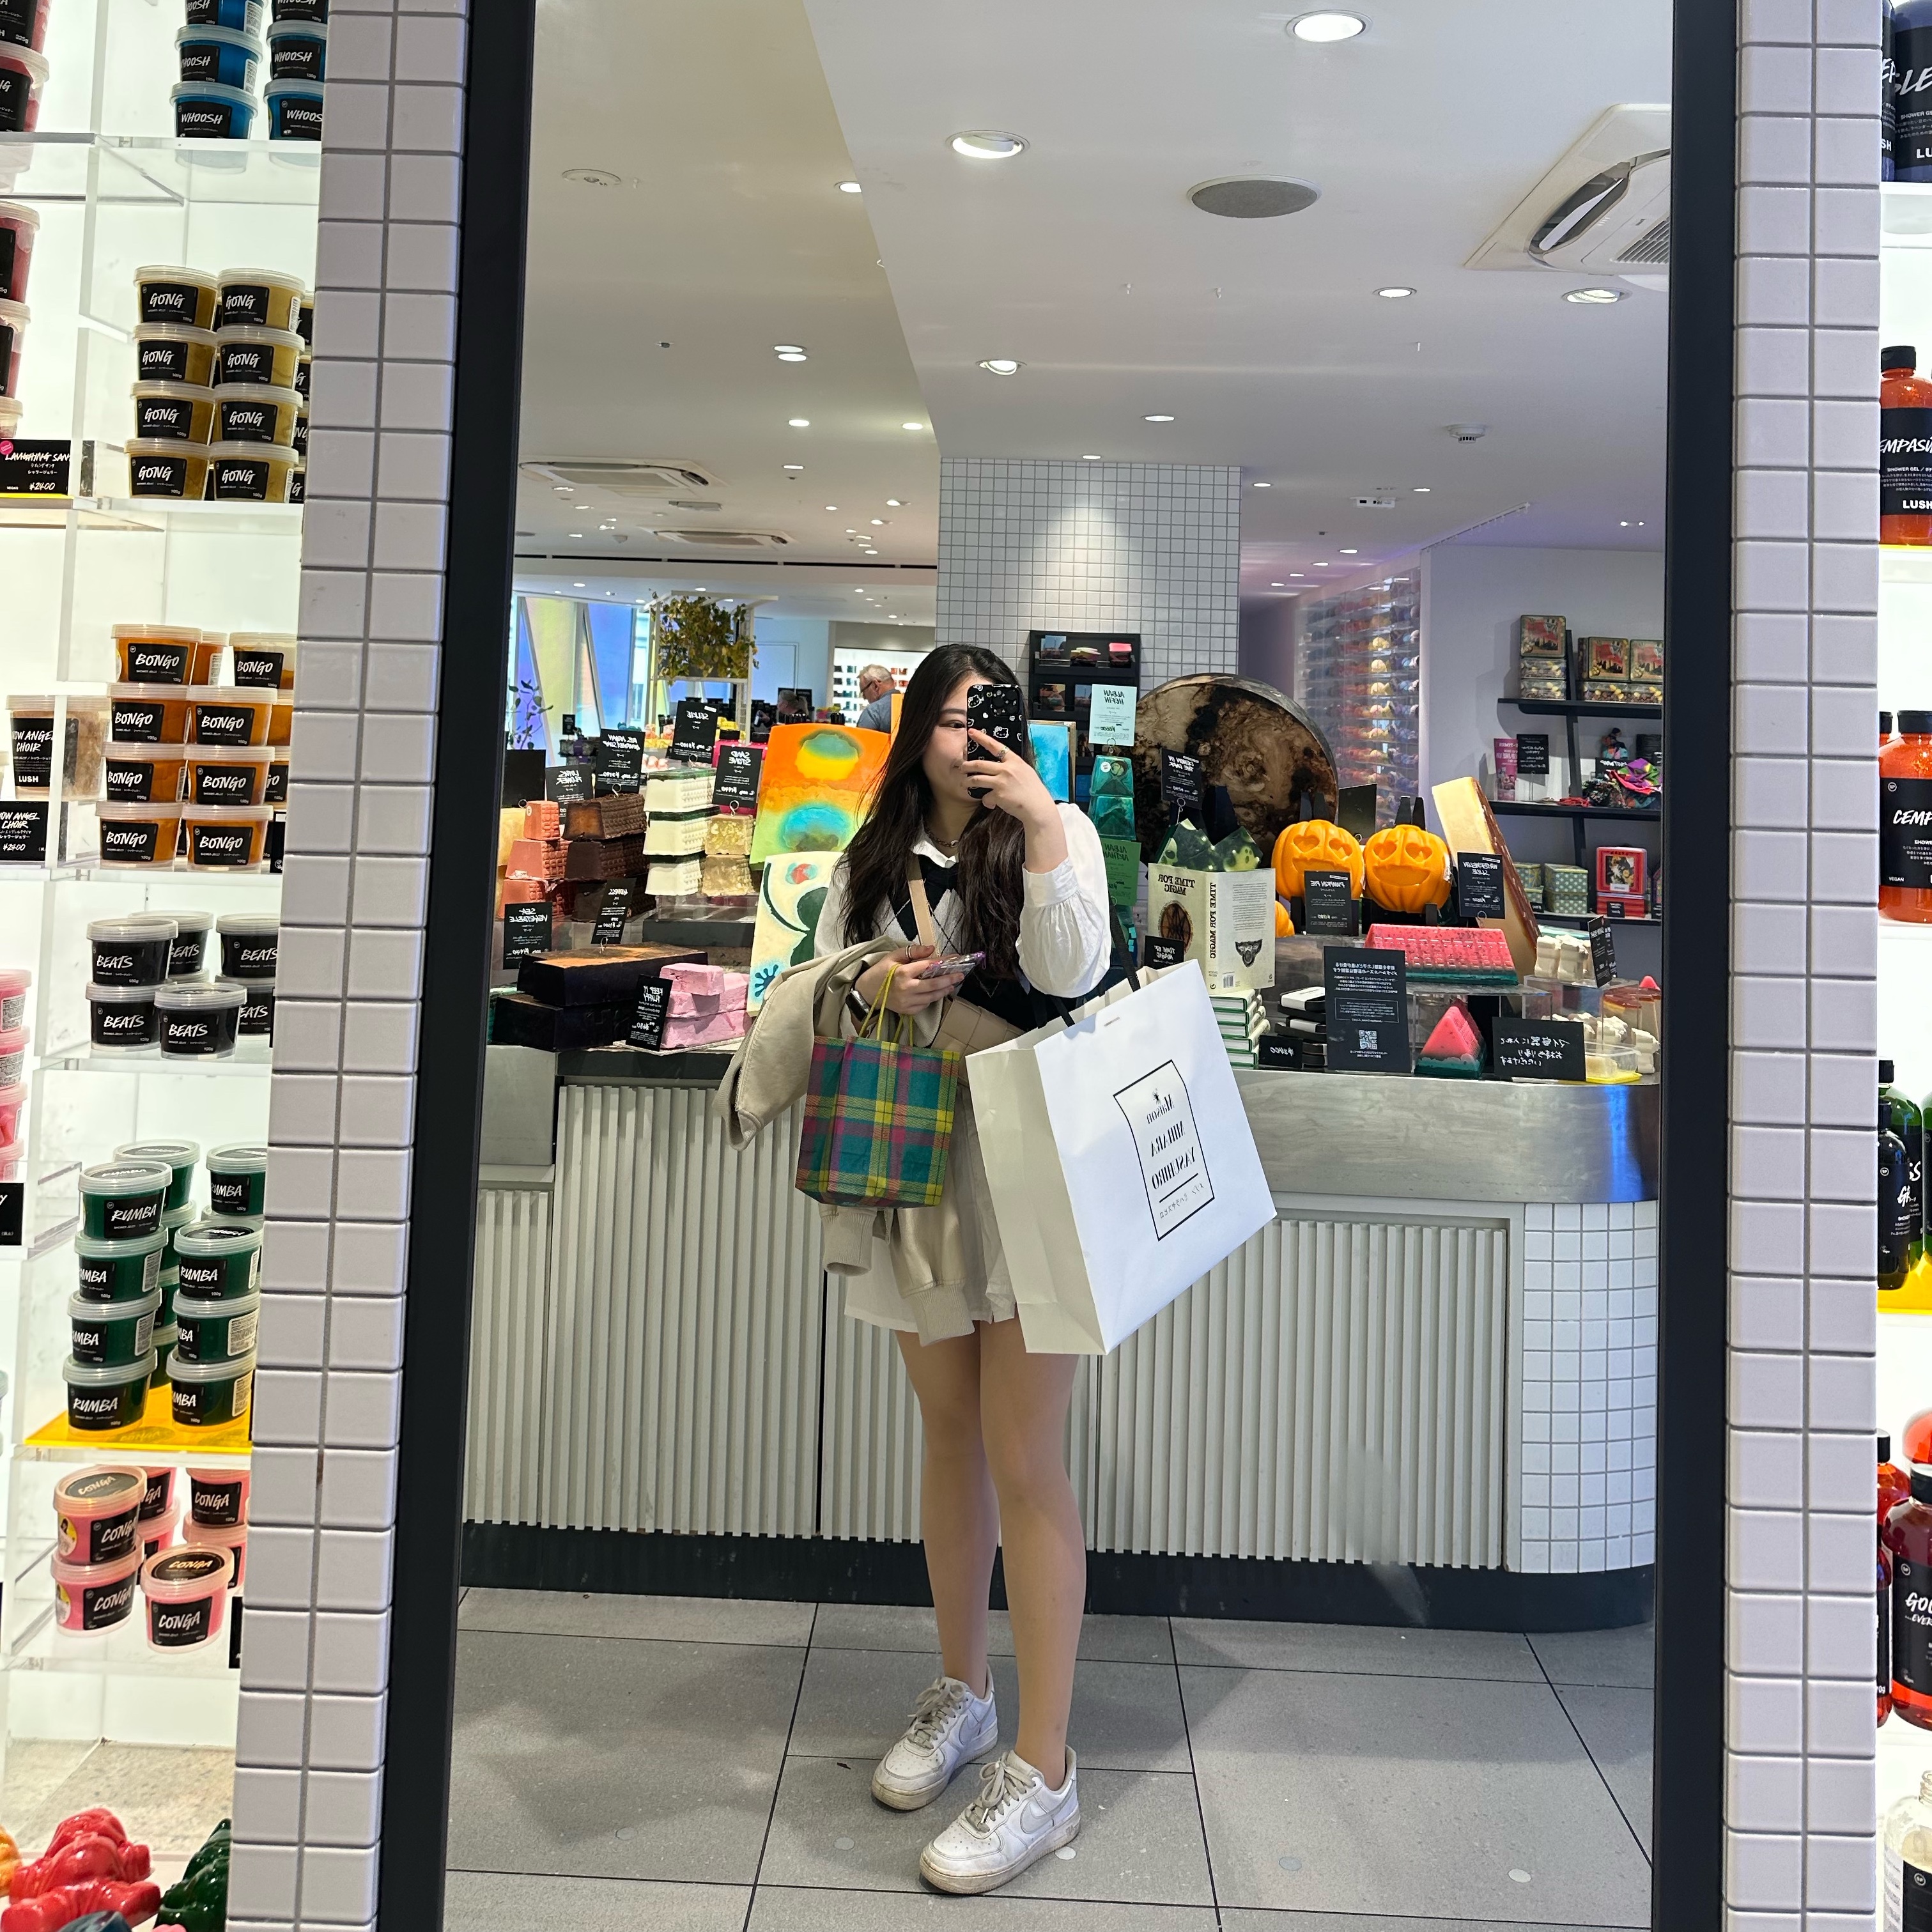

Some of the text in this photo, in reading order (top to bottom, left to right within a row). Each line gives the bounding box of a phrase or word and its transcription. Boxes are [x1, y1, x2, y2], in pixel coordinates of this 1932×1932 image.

[274, 52, 313, 63] WHOOSH
[181, 113, 223, 124] WHOOSH
[1901, 111, 1925, 120] SHOWER
[150, 293, 185, 309] GONG
[226, 294, 256, 309] GONG
[142, 350, 174, 366] GONG
[227, 353, 259, 367] GONG
[144, 408, 180, 424] GONG
[229, 411, 265, 427] GONG
[5, 452, 52, 461] LAUGHING
[138, 465, 174, 481] GONG
[222, 468, 256, 484] GONG
[29, 482, 56, 491] ¥2400
[135, 653, 180, 669] BONGO
[236, 660, 274, 676] BONGO
[114, 712, 153, 727] BONGO
[201, 716, 244, 733] BONGO
[16, 742, 41, 752] CHOIR
[107, 771, 143, 787] BONGO
[202, 776, 247, 792] BONGO
[13, 812, 40, 821] ANGEL
[105, 831, 148, 848] BONGO
[199, 836, 243, 853] BONGO
[96, 955, 134, 970] BEATS
[240, 948, 277, 961] BEATS
[104, 1015, 145, 1029] BEATS
[168, 1023, 208, 1037] BEATS
[211, 1183, 242, 1197] RUMBA
[111, 1202, 157, 1222] RUMBA
[180, 1265, 218, 1282] RUMBA
[73, 1396, 118, 1413] RUMBA
[78, 1476, 117, 1496] CONGA
[194, 1491, 229, 1508] CONGA
[169, 1560, 213, 1570] CONGA
[94, 1586, 132, 1612] CONGA
[158, 1611, 200, 1630] CONGA
